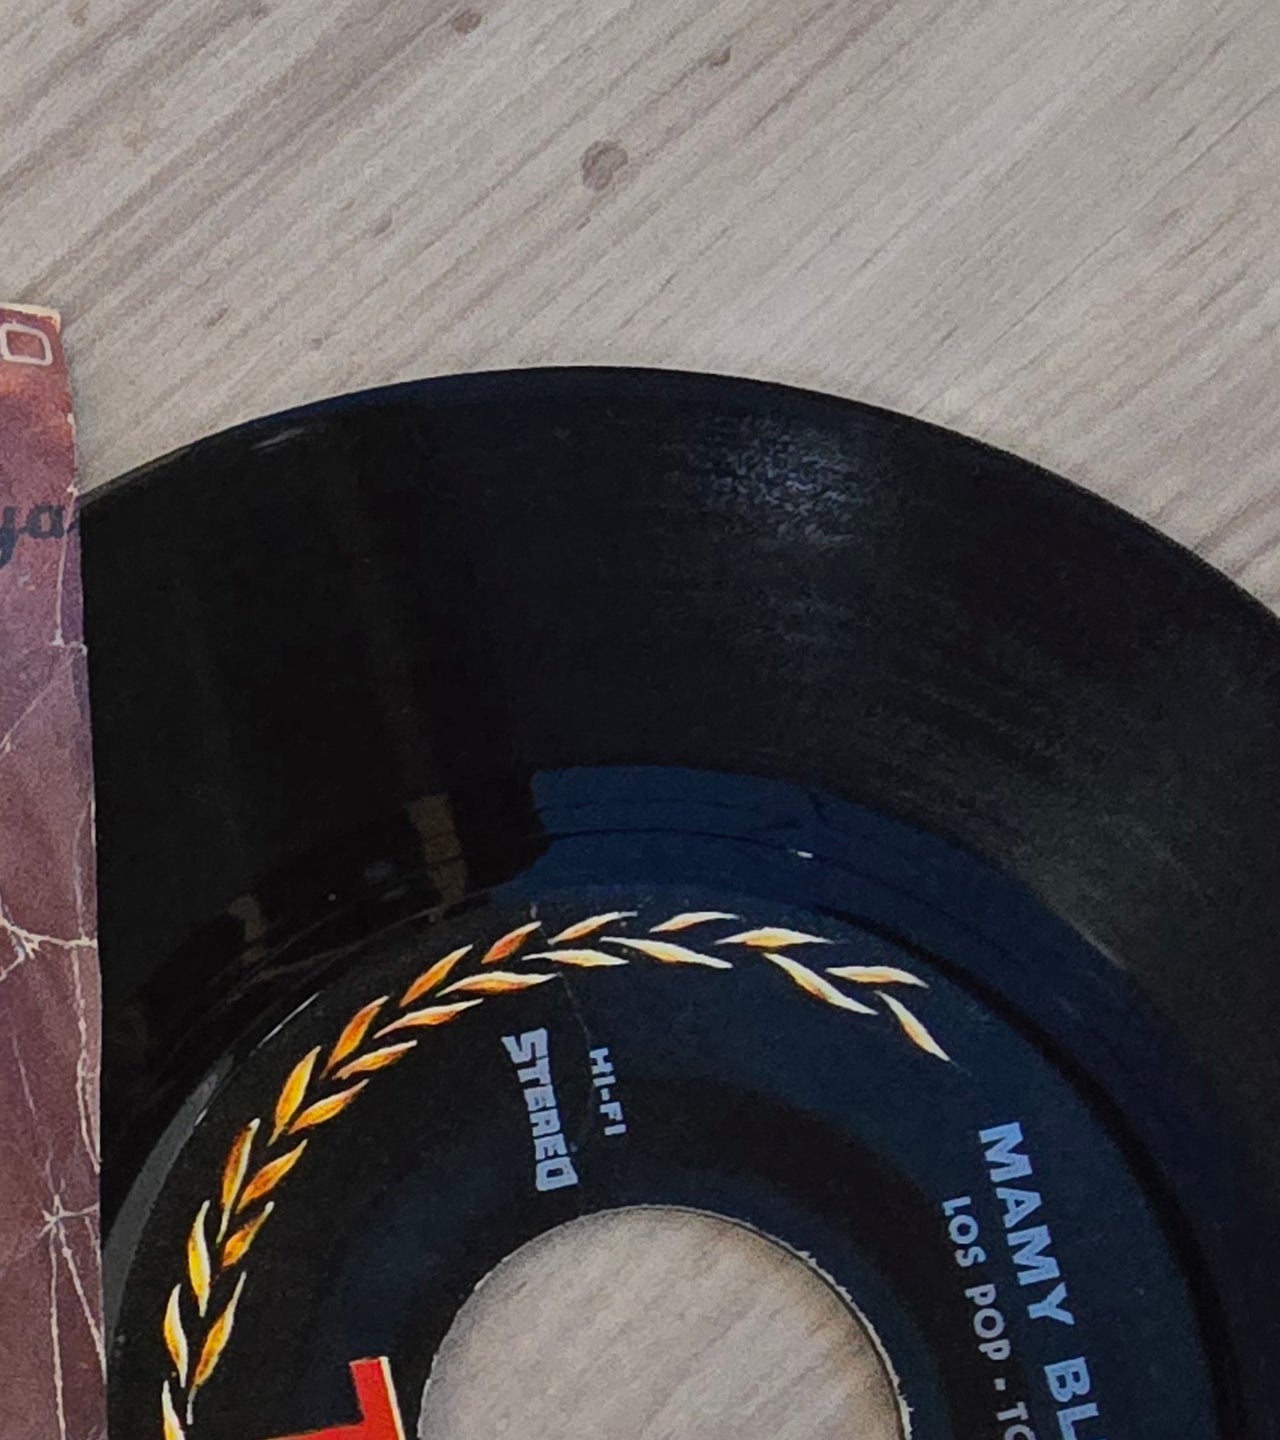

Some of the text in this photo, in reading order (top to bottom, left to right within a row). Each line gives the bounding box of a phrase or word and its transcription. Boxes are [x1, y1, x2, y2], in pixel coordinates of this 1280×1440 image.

[502, 1027, 579, 1192] STEREO
[589, 1046, 627, 1137] HI-FI
[941, 1195, 986, 1267] LOS
[964, 1284, 1008, 1365] POP
[978, 1121, 1075, 1328] MAMY
